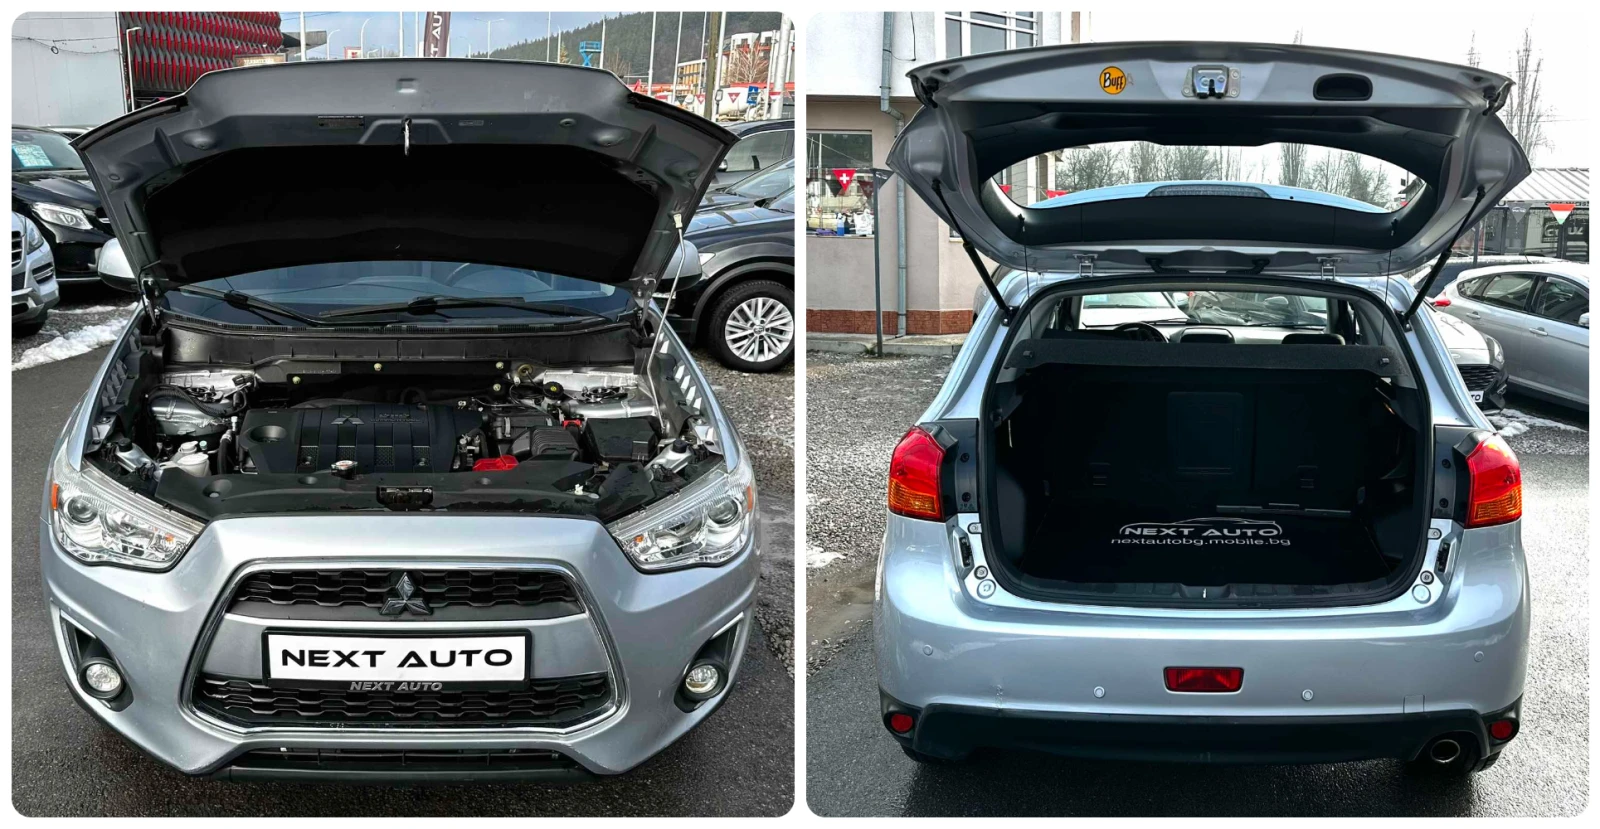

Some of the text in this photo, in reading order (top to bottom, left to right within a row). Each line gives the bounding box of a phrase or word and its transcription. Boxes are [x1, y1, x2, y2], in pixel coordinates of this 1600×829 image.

[1124, 527, 1279, 537] NEXT AUTO
[1111, 537, 1291, 546] nextautobg.mobile.bg
[281, 648, 513, 668] NEXT AUTO
[350, 681, 443, 692] NEXT AUTO
